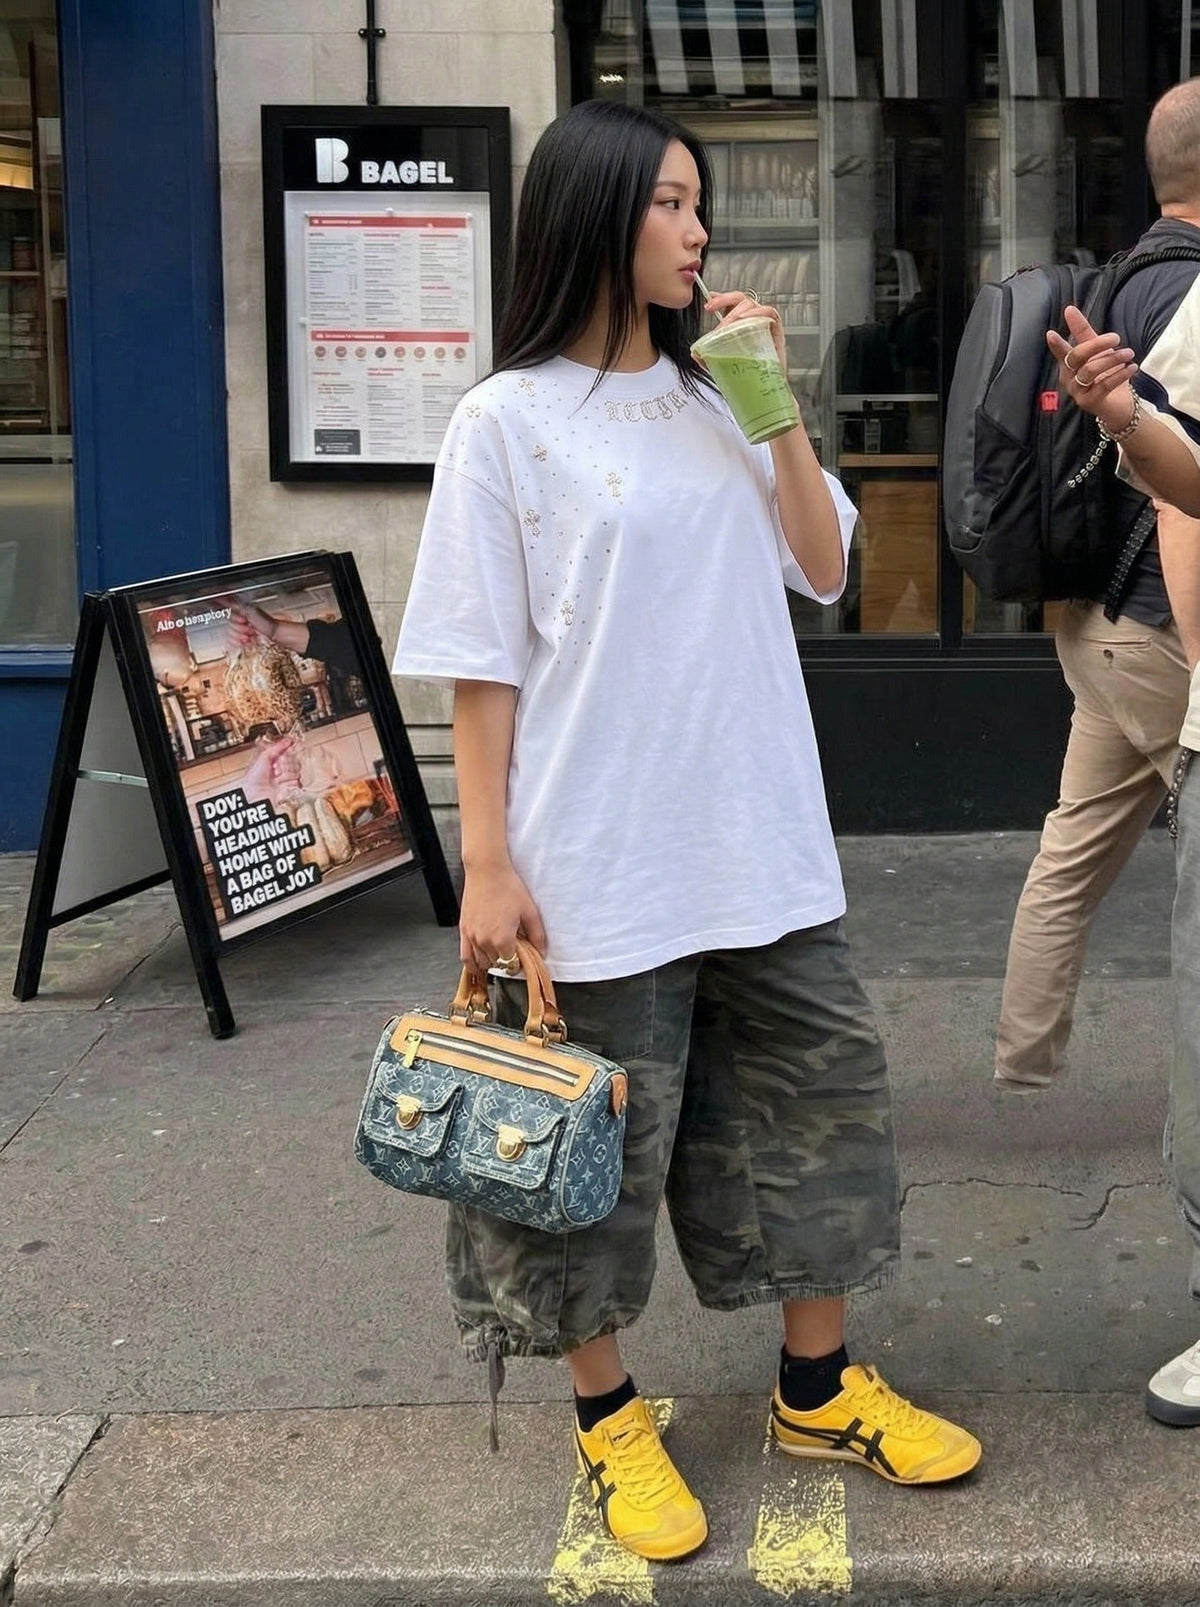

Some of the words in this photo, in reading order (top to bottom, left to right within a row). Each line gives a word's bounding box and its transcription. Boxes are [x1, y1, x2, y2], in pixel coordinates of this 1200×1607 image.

[315, 138, 349, 183] B
[361, 161, 454, 184] BAGEL
[203, 793, 244, 820] DOV:
[208, 803, 270, 838] YOU'RE
[214, 817, 288, 858] HEADING
[219, 844, 270, 877] HOME
[267, 827, 311, 857] WITH
[227, 877, 241, 896] A
[239, 863, 275, 890] BAG
[275, 853, 297, 874] OF
[230, 880, 286, 915] BAGEL
[285, 865, 316, 892] JOY
